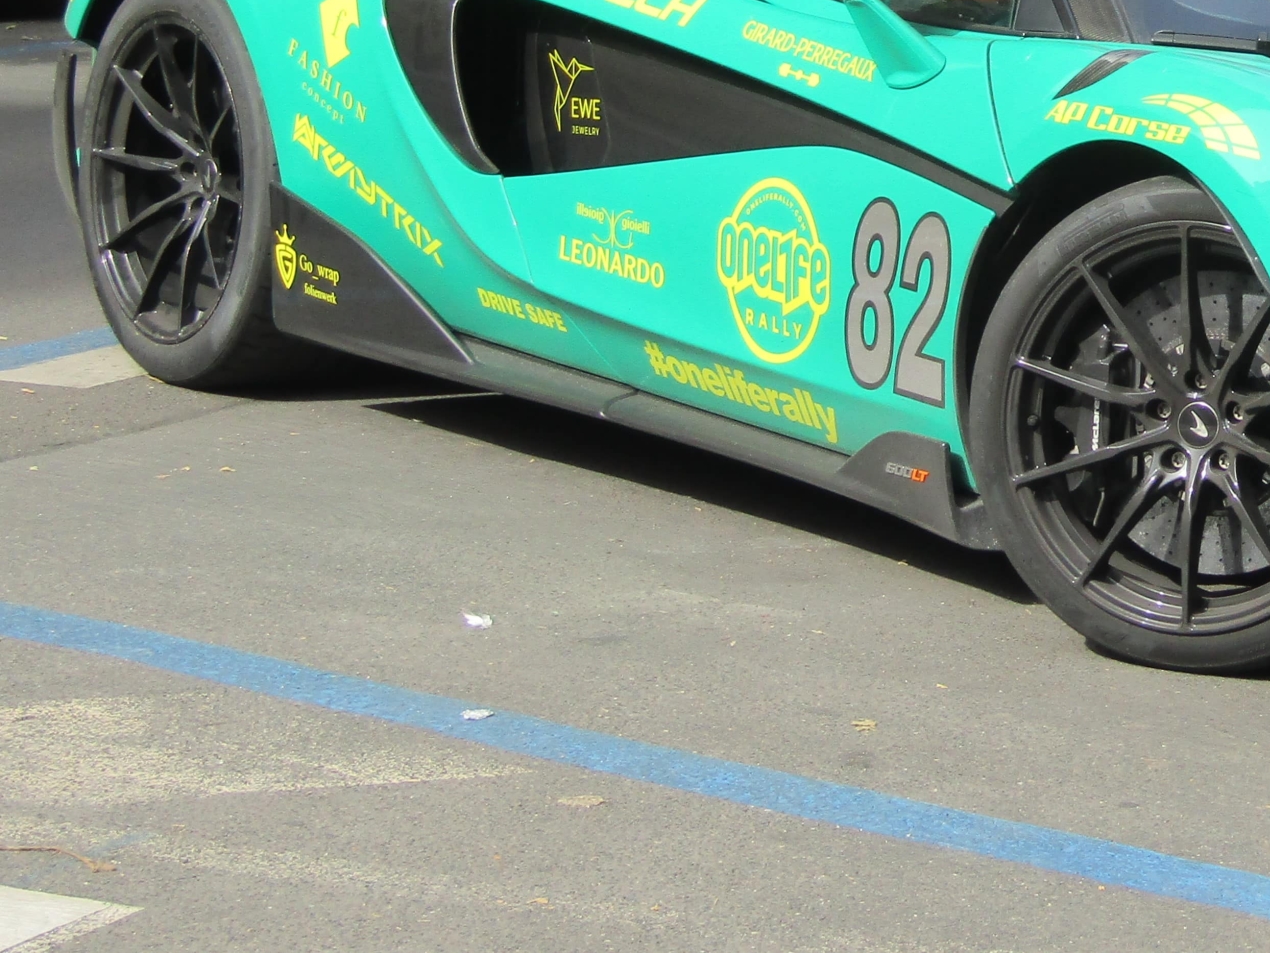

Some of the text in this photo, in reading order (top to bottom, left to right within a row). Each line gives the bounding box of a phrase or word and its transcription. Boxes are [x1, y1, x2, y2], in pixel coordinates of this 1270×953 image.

[742, 19, 877, 82] GIRARD-PERREGAUX
[288, 38, 367, 123] FASHION
[301, 79, 345, 125] concept
[571, 97, 601, 120] EWE
[571, 125, 600, 136] JEWELRY
[1086, 104, 1191, 145] Corse
[621, 217, 650, 235] gioielli
[745, 192, 807, 232] ONELIFERALLY.COM
[300, 254, 339, 286] Go_wrap
[559, 235, 665, 288] LEONARDO
[477, 287, 568, 332] DRIVE SAFE
[844, 196, 952, 408] 82
[745, 307, 802, 340] RALLY
[644, 340, 839, 444] #oneliferally
[885, 462, 929, 482] 600LT
